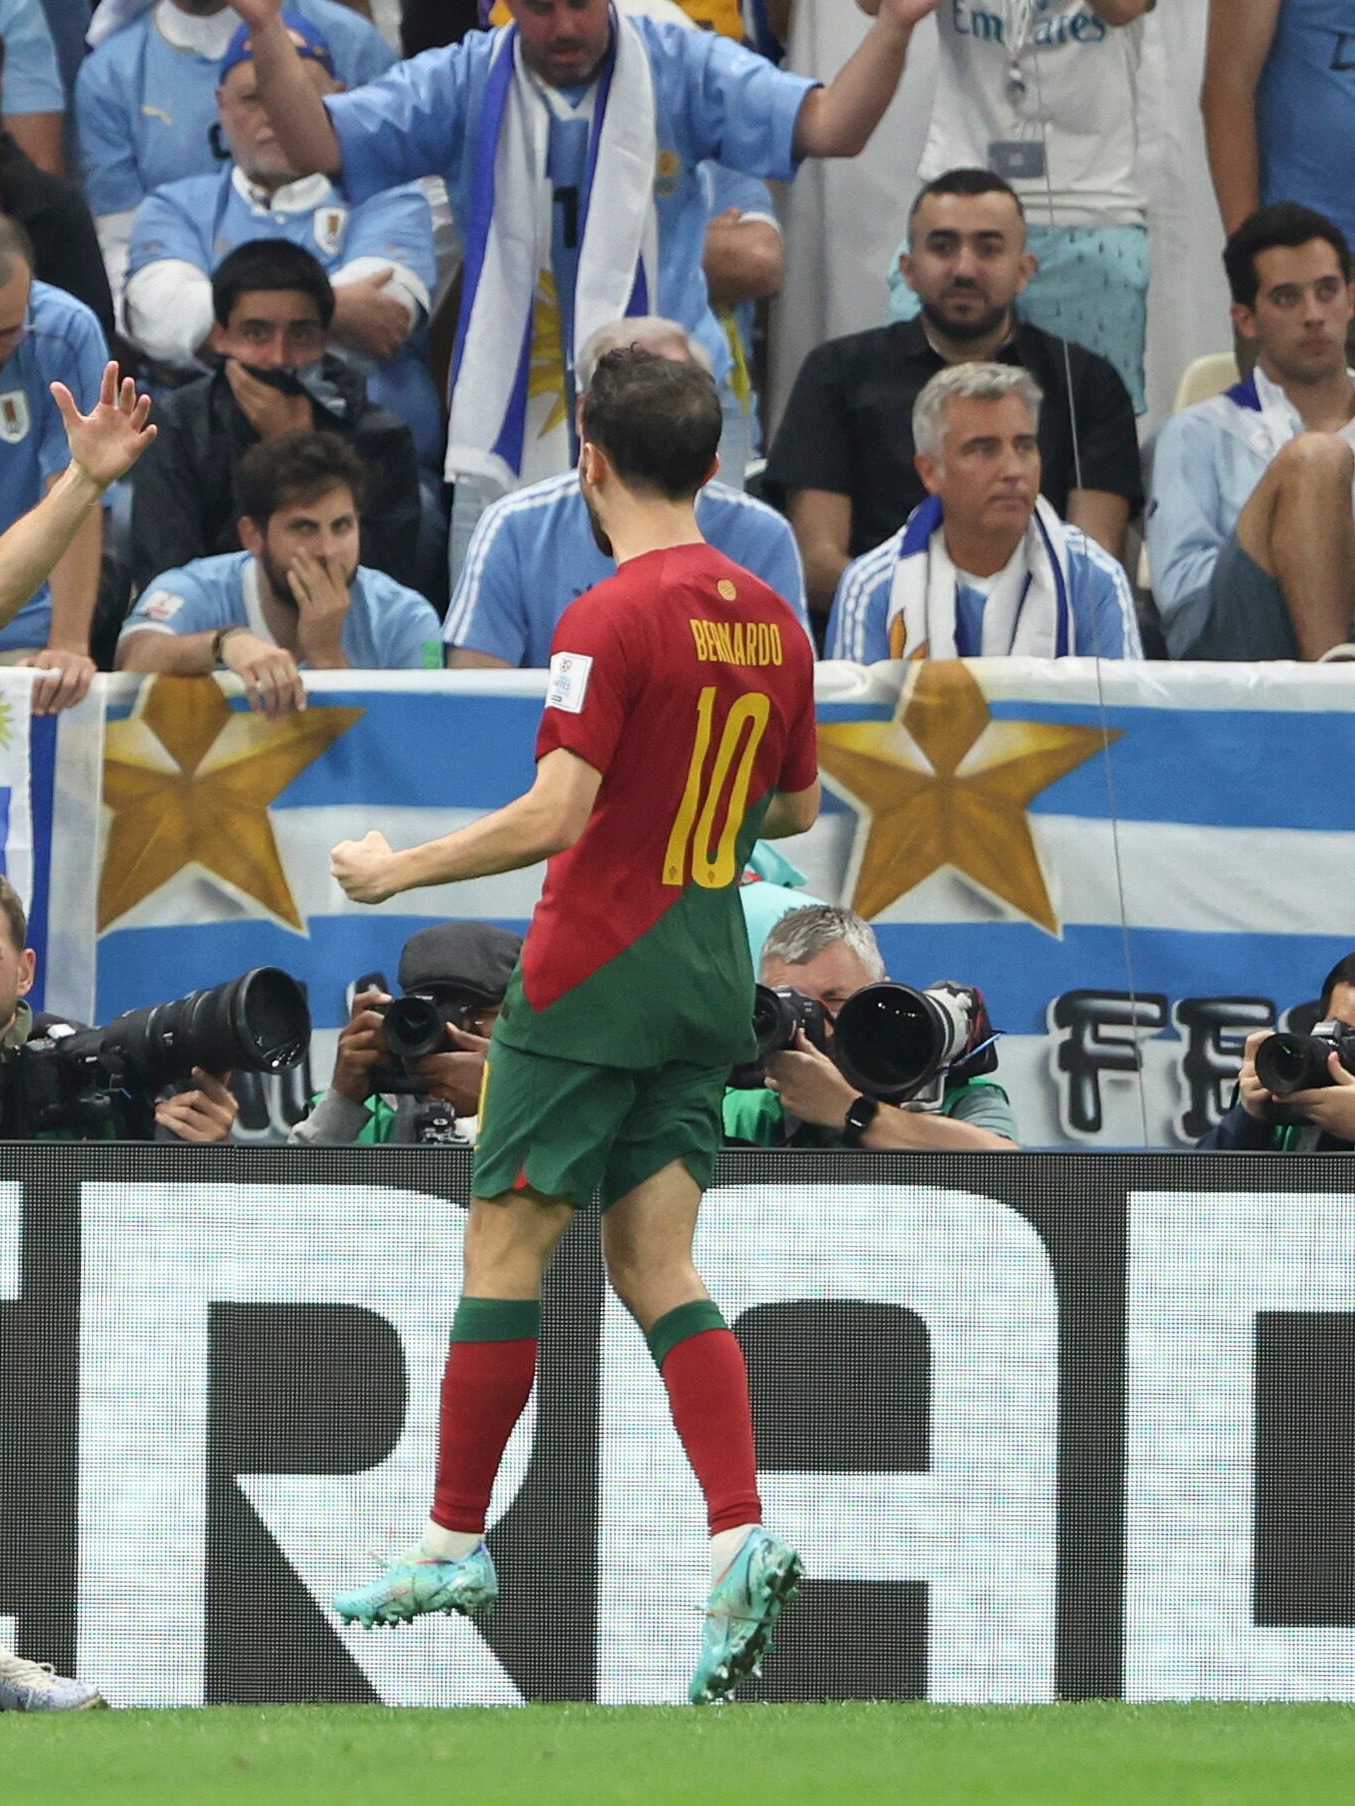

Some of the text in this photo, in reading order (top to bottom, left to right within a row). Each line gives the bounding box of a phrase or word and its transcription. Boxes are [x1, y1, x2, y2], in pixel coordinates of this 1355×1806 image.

[954, 0, 1106, 46] Emates
[689, 618, 783, 666] BERNARDO
[661, 686, 771, 889] 10
